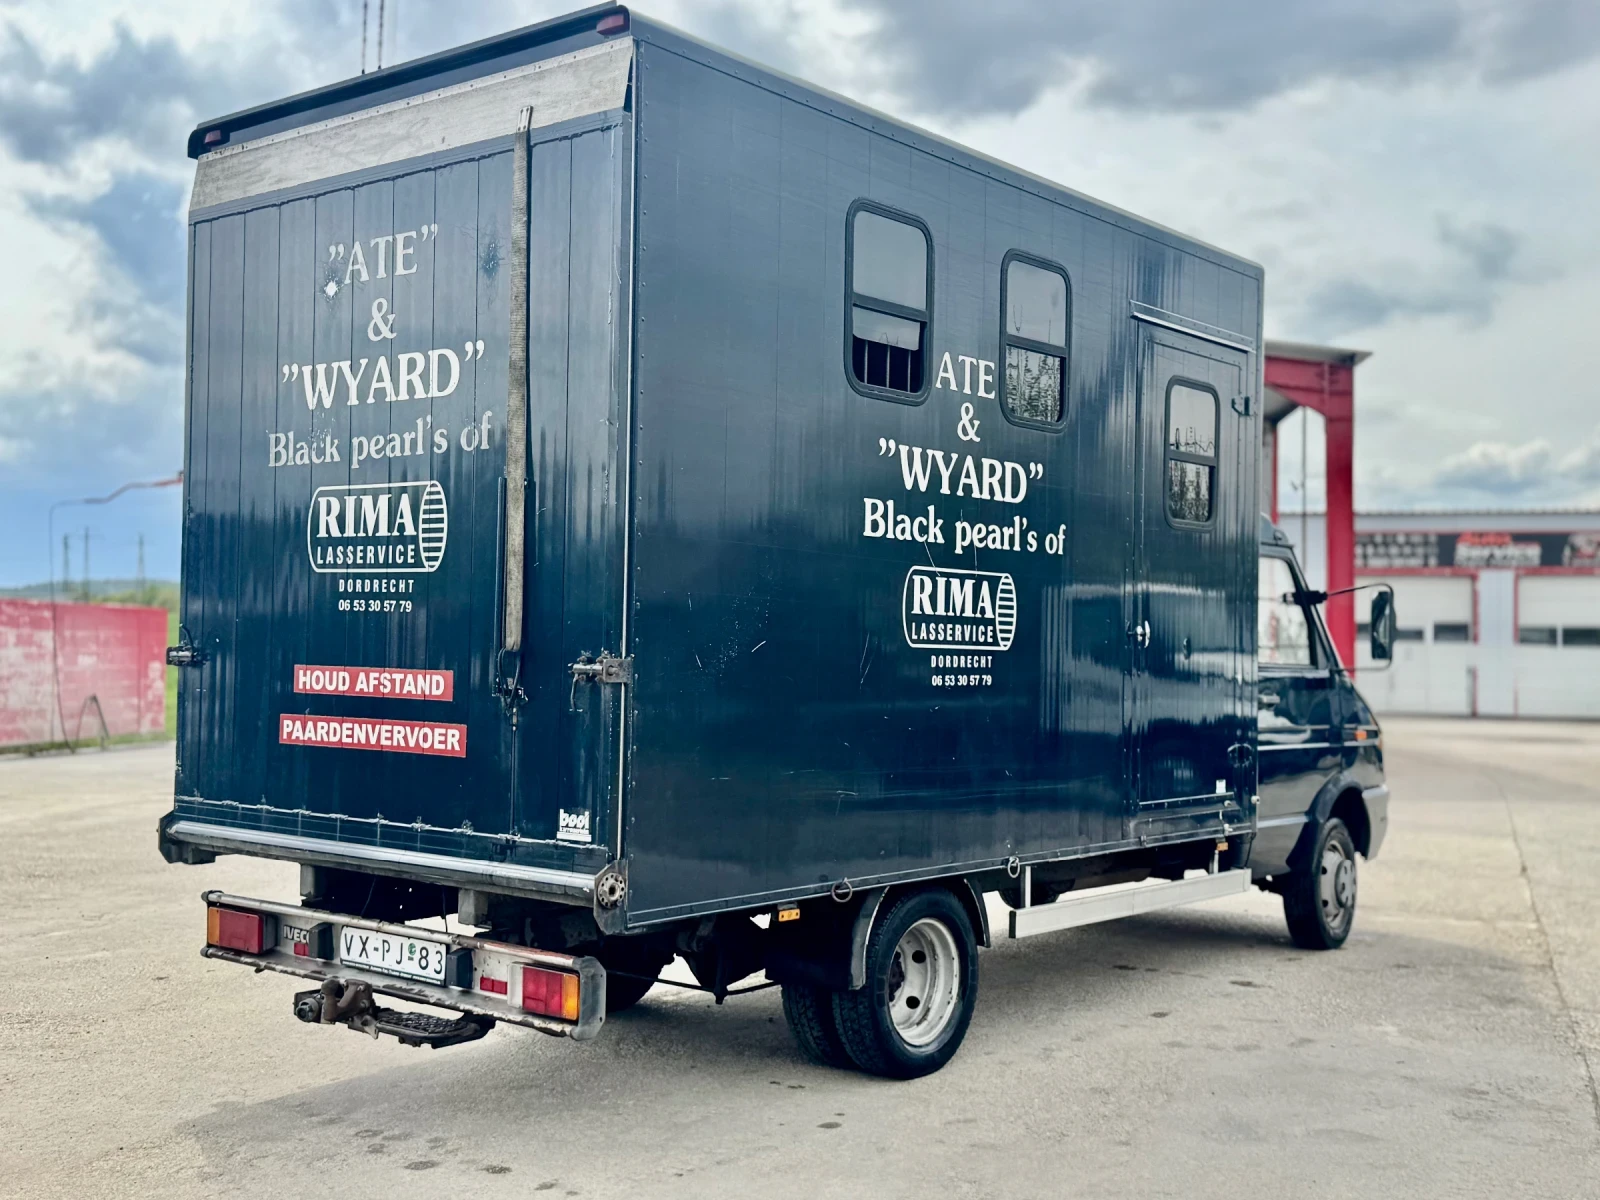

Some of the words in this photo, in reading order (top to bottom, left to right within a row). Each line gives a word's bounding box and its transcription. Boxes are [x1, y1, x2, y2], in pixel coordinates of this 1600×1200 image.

[367, 298, 397, 342] &
[935, 351, 996, 400] ATE
[268, 430, 341, 467] Black
[351, 415, 448, 469] pearl's
[460, 410, 493, 452] of
[957, 402, 981, 443] &
[316, 493, 417, 538] RIMA
[863, 497, 945, 544] Black
[954, 515, 1038, 555] pearl's
[1045, 523, 1067, 555] of
[316, 544, 416, 565] LASSERVICE
[338, 578, 414, 593] DORDRECHT
[911, 574, 995, 619] RIMA
[338, 599, 351, 612] 06
[353, 599, 366, 612] 53
[368, 599, 381, 612] 30
[383, 600, 397, 612] 57
[399, 600, 412, 613] 79
[911, 622, 994, 643] LASSERVICE
[930, 655, 993, 668] DORDRECHT
[298, 669, 350, 692] HOUD
[355, 672, 445, 696] AFSTAND
[931, 675, 942, 686] 06
[944, 675, 955, 686] 53
[957, 675, 968, 686] 30
[969, 675, 980, 686] 57
[981, 675, 992, 686] 79
[282, 720, 460, 751] PAARDENVERVOER
[344, 933, 443, 975] VX-PJ-83
